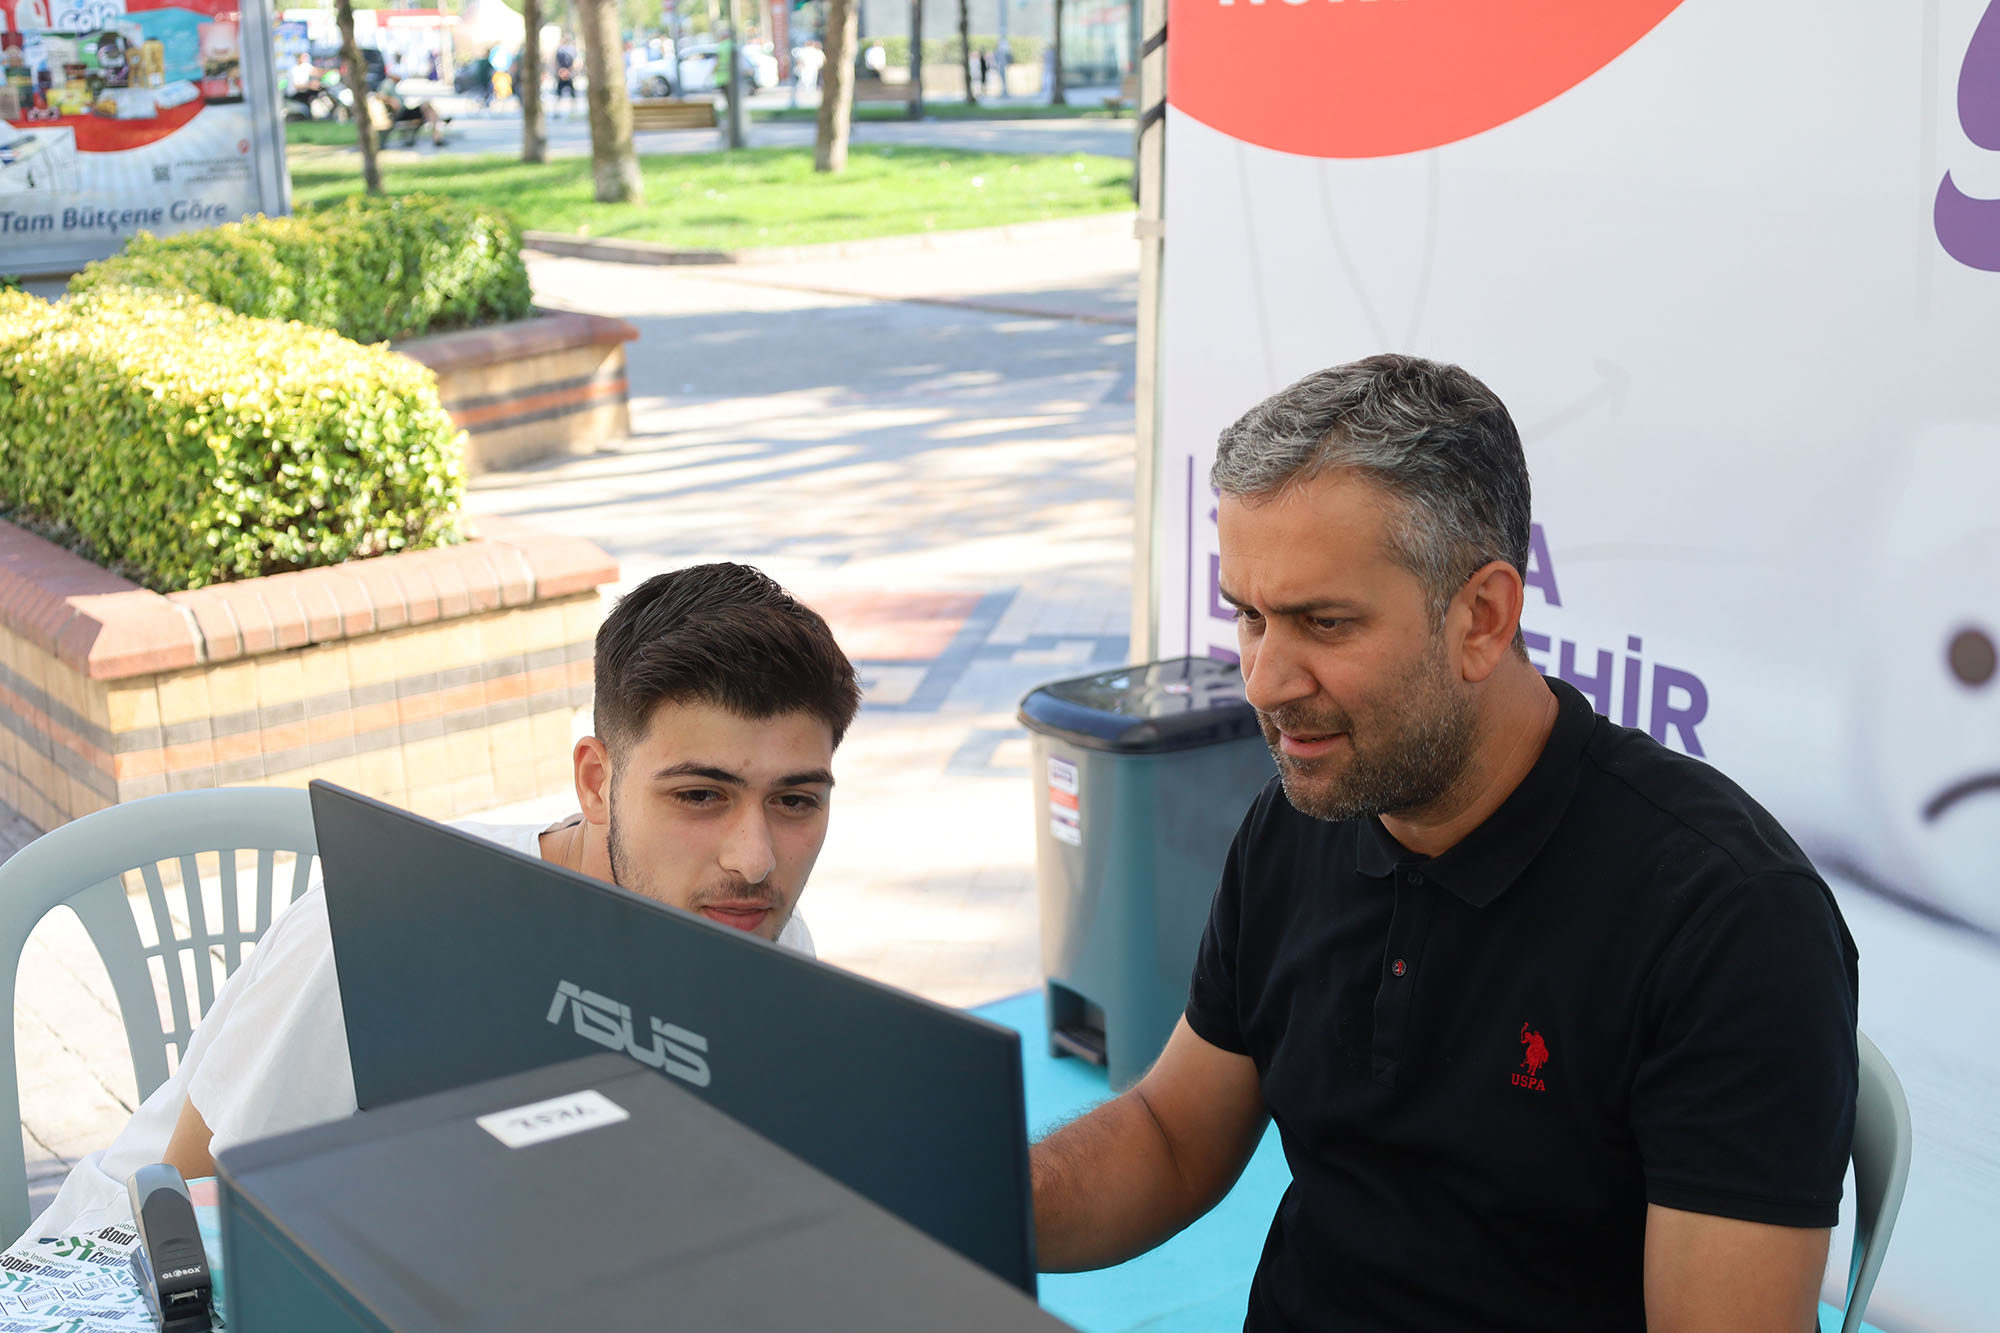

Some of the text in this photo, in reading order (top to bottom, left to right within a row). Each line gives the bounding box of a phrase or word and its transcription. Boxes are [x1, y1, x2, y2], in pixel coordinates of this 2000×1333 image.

[0, 200, 226, 233] Tam Bütçene Göre
[547, 980, 711, 1087] ASUS
[1511, 1073, 1546, 1091] USPA
[98, 1227, 137, 1246] Bond
[36, 1265, 75, 1279] Bond
